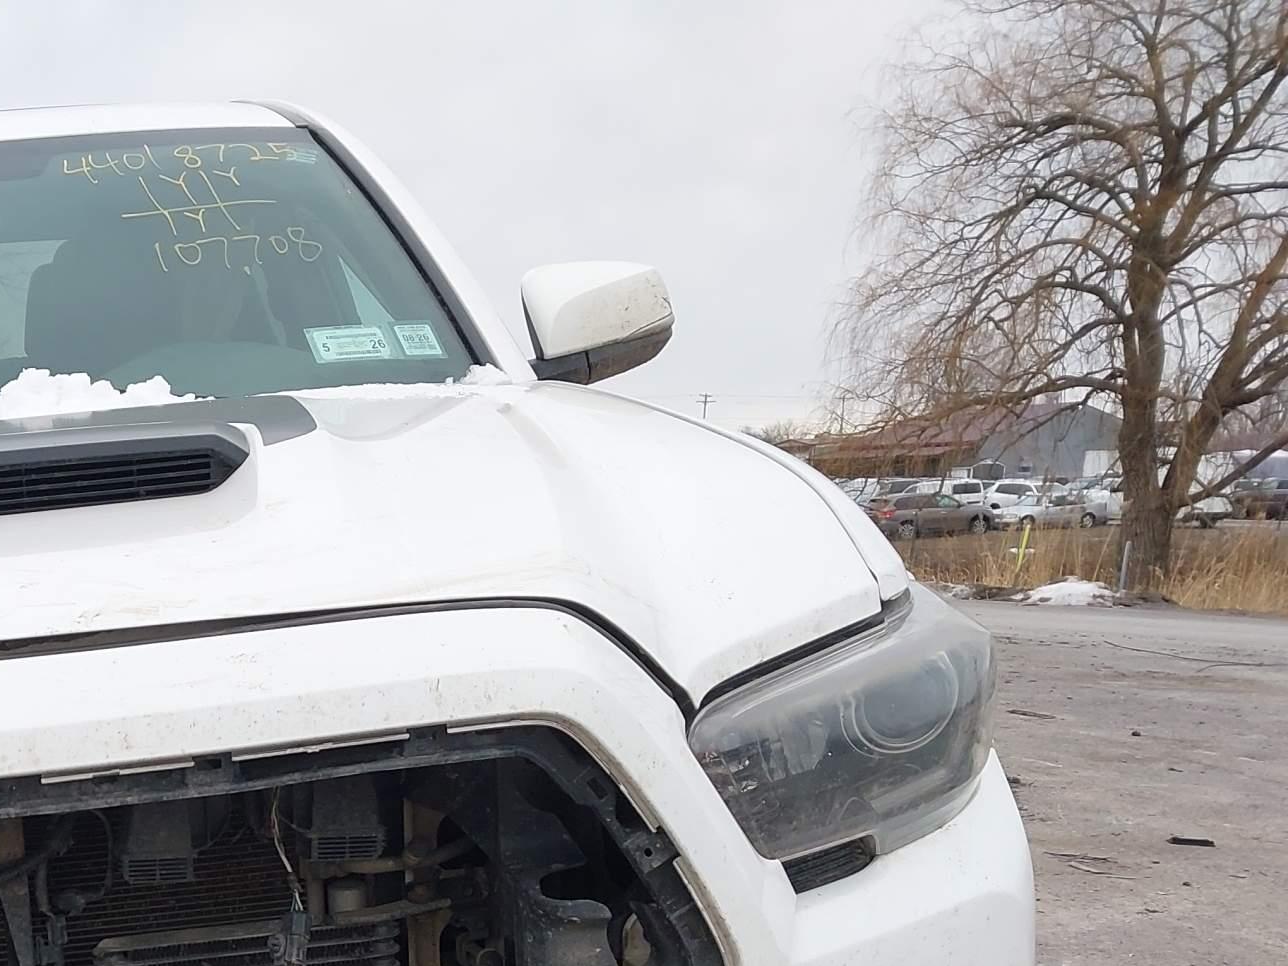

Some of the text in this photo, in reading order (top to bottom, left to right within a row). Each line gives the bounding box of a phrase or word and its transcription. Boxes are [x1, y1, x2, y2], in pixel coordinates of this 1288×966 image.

[64, 143, 297, 184] 44018725
[322, 342, 331, 353] 5
[369, 338, 387, 350] 26
